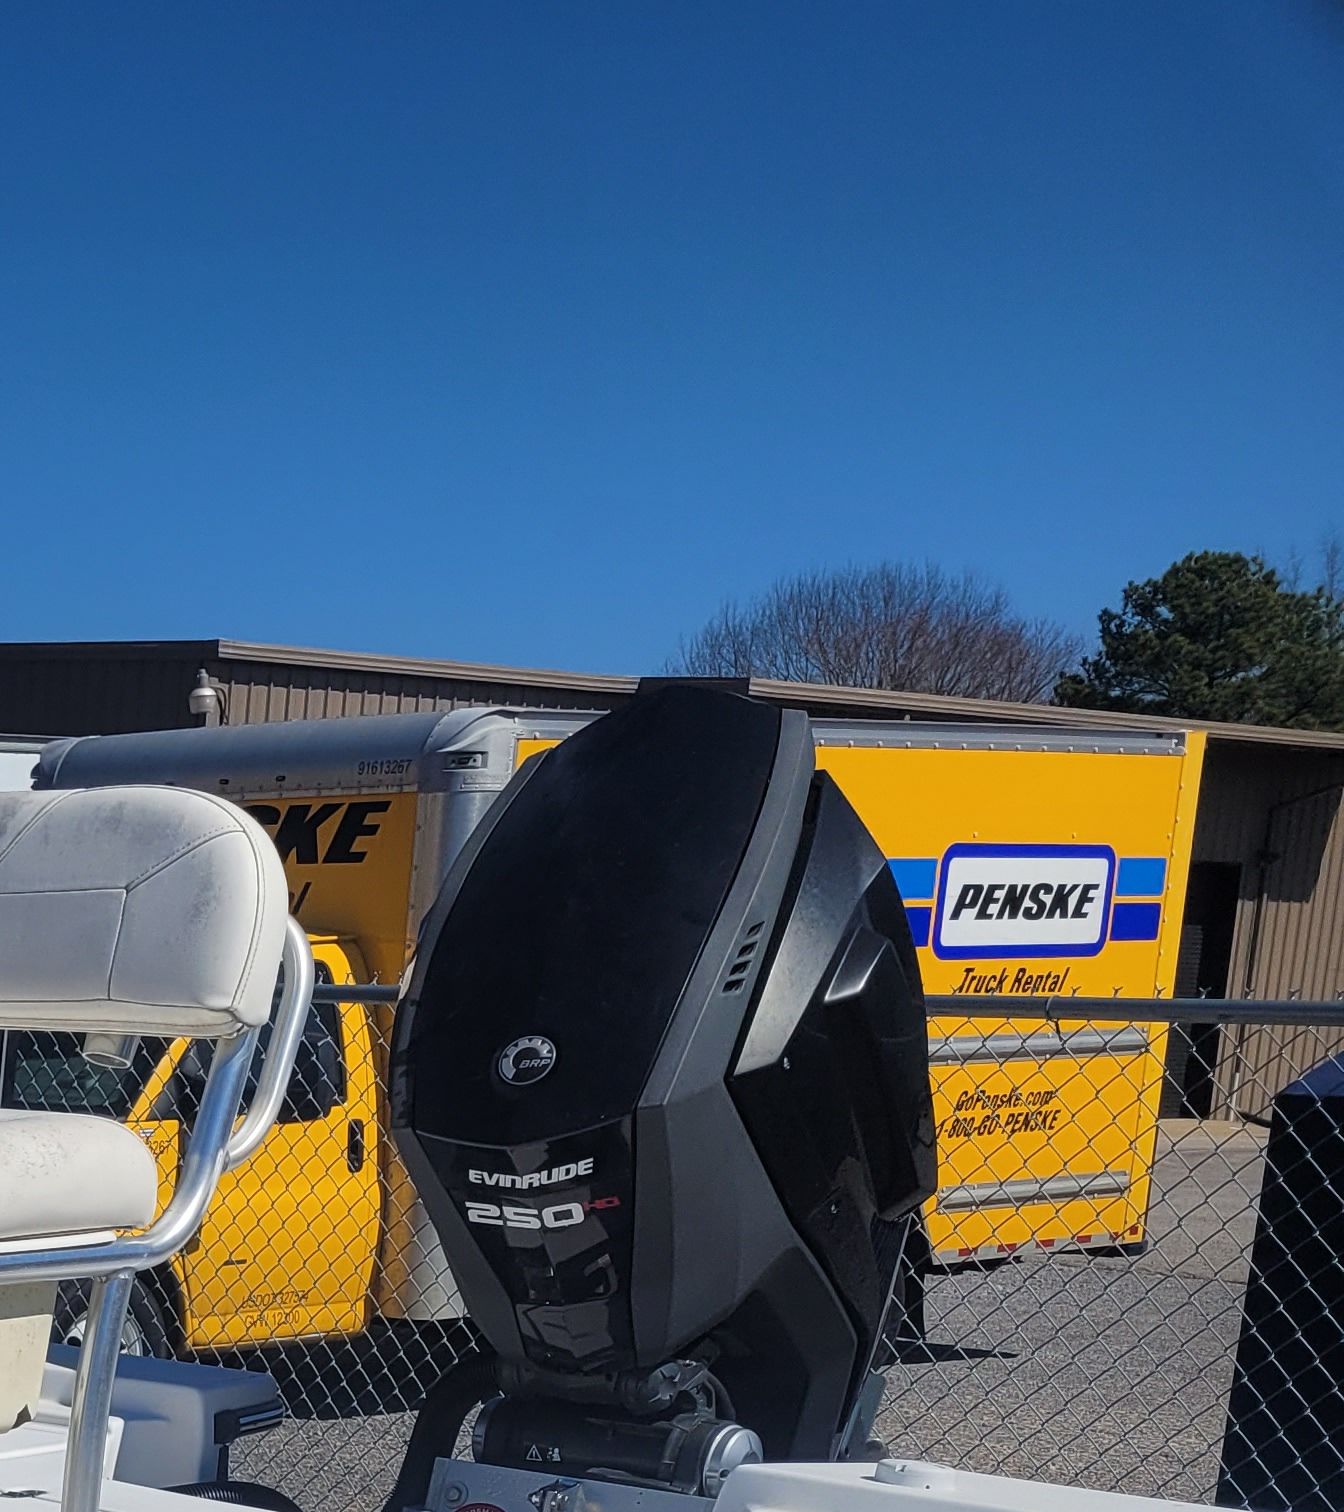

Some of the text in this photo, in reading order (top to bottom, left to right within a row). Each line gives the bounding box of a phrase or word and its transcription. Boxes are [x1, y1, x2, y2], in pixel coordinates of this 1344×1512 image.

[948, 882, 1100, 921] PENSKE
[959, 966, 1071, 994] Truck Rental
[518, 1058, 552, 1069] BRP
[468, 1157, 594, 1190] EVINRUDE
[465, 1201, 585, 1230] 250
